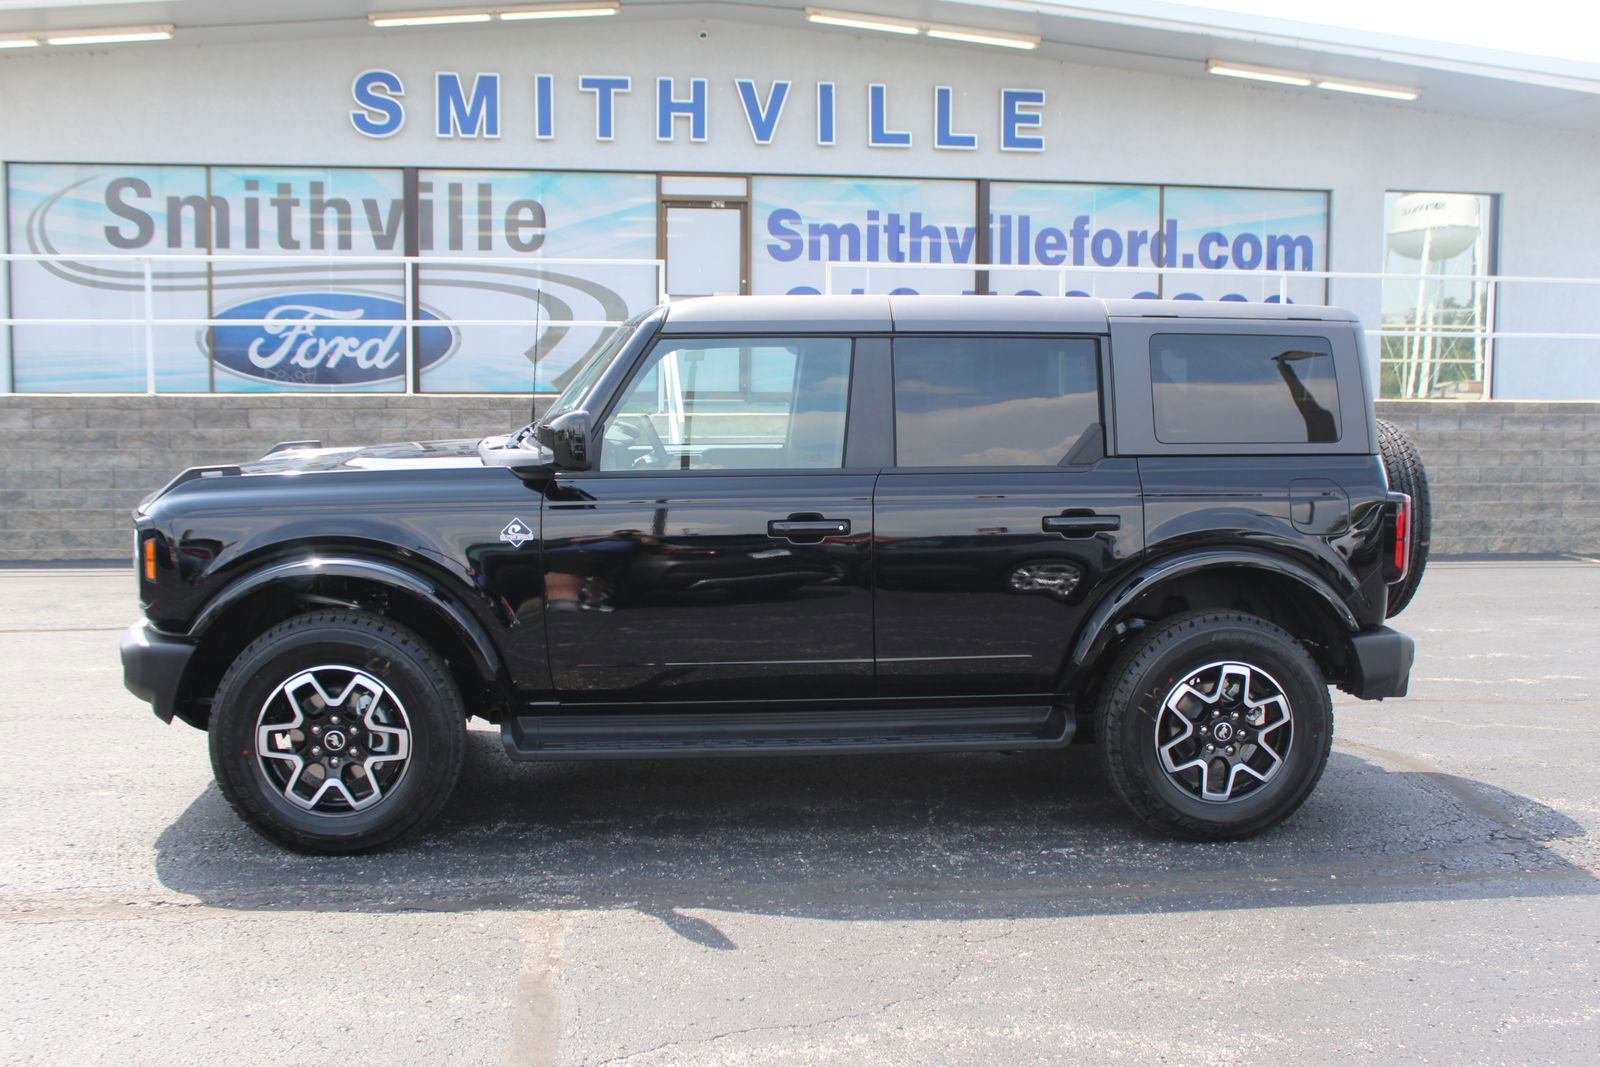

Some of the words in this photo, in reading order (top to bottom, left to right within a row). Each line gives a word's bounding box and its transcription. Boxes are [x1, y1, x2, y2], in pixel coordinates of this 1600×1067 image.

[350, 68, 1046, 152] SMITHVILLE
[103, 175, 547, 253] Smithville
[248, 304, 404, 370] Ford
